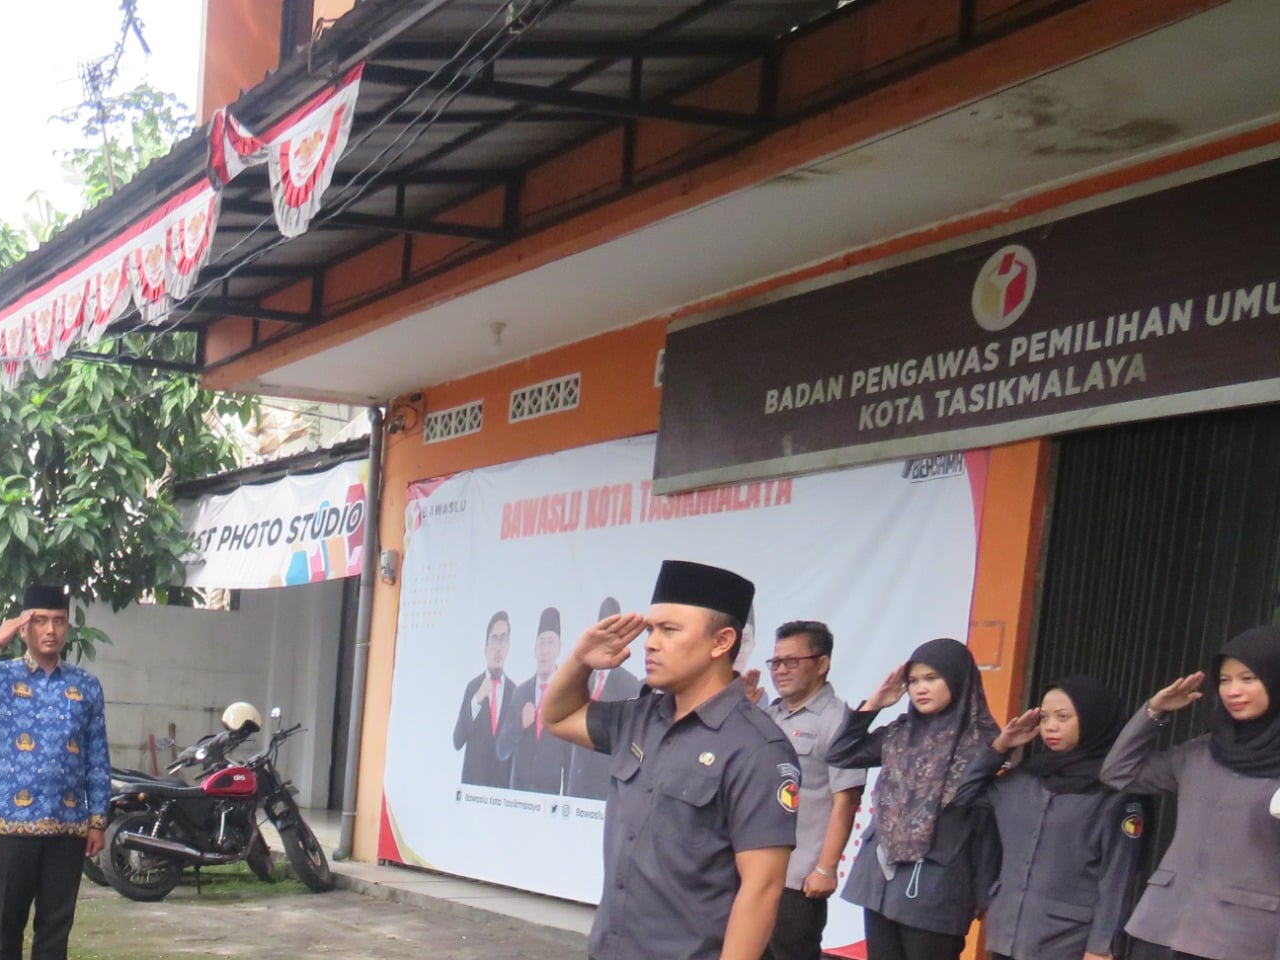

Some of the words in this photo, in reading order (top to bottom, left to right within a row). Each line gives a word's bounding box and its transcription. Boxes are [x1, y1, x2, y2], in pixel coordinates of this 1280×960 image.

[764, 375, 844, 415] BADAN
[850, 342, 1001, 397] PENGAWAS
[1009, 299, 1194, 367] PEMILIHAN
[858, 395, 925, 431] KOTA
[935, 352, 1147, 418] TASIKMALAYA
[217, 517, 283, 551] PHOTO
[286, 502, 365, 545] STUDIO
[500, 490, 583, 541] BAWASLU
[585, 481, 634, 530] KOTA
[464, 793, 489, 805] Bawaslu
[489, 796, 502, 807] Kota
